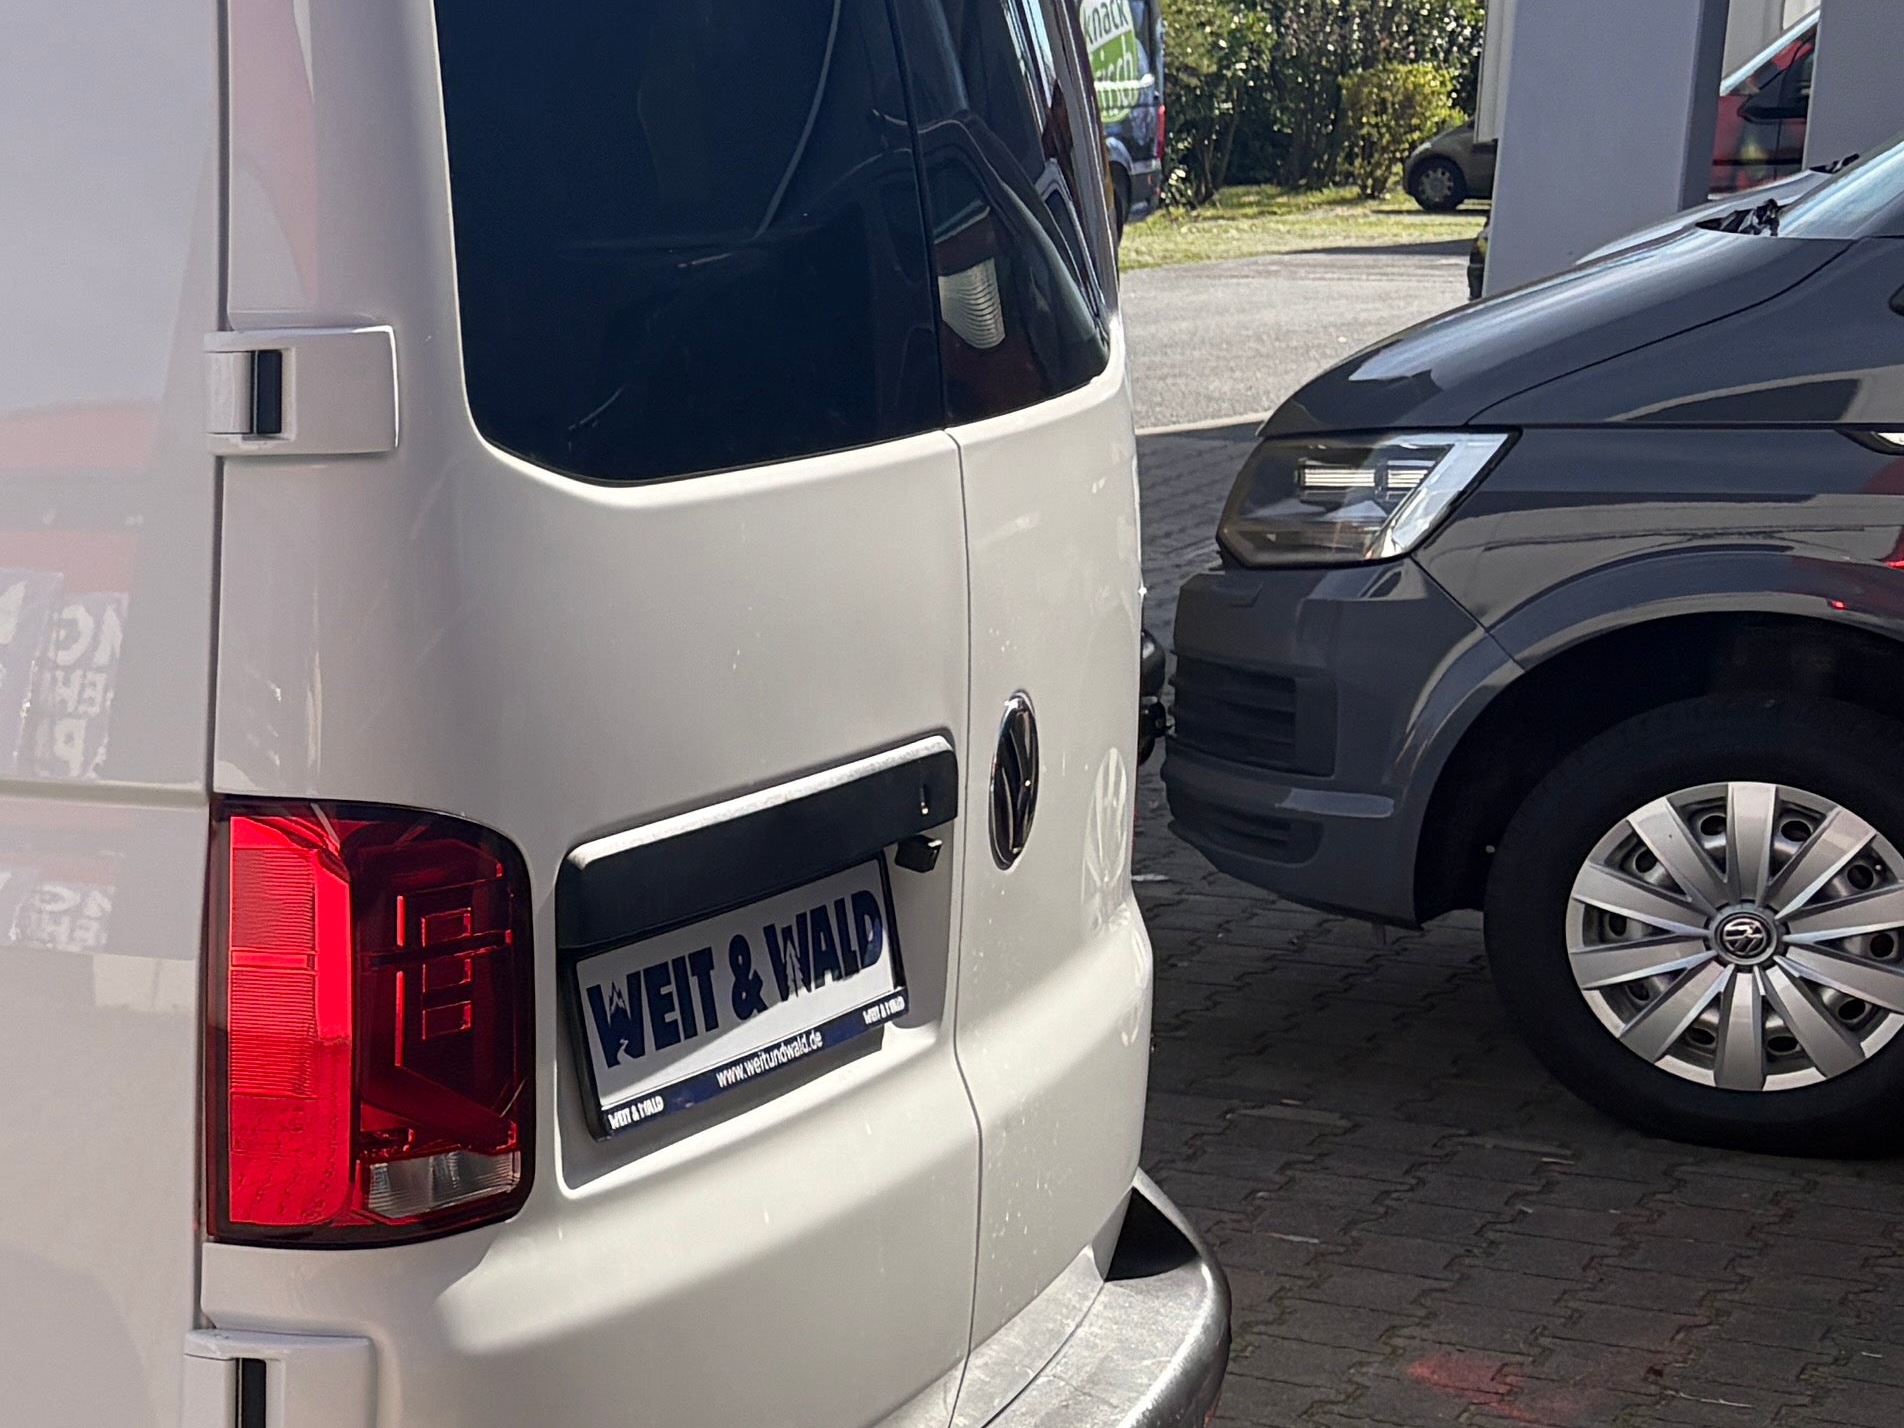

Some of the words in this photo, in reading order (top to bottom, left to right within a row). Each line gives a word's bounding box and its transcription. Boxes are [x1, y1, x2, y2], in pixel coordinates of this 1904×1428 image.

[587, 945, 720, 1068] WEIT
[727, 933, 769, 1021] &
[764, 889, 884, 1002] WALD
[715, 1029, 823, 1089] www.weitundwald.de
